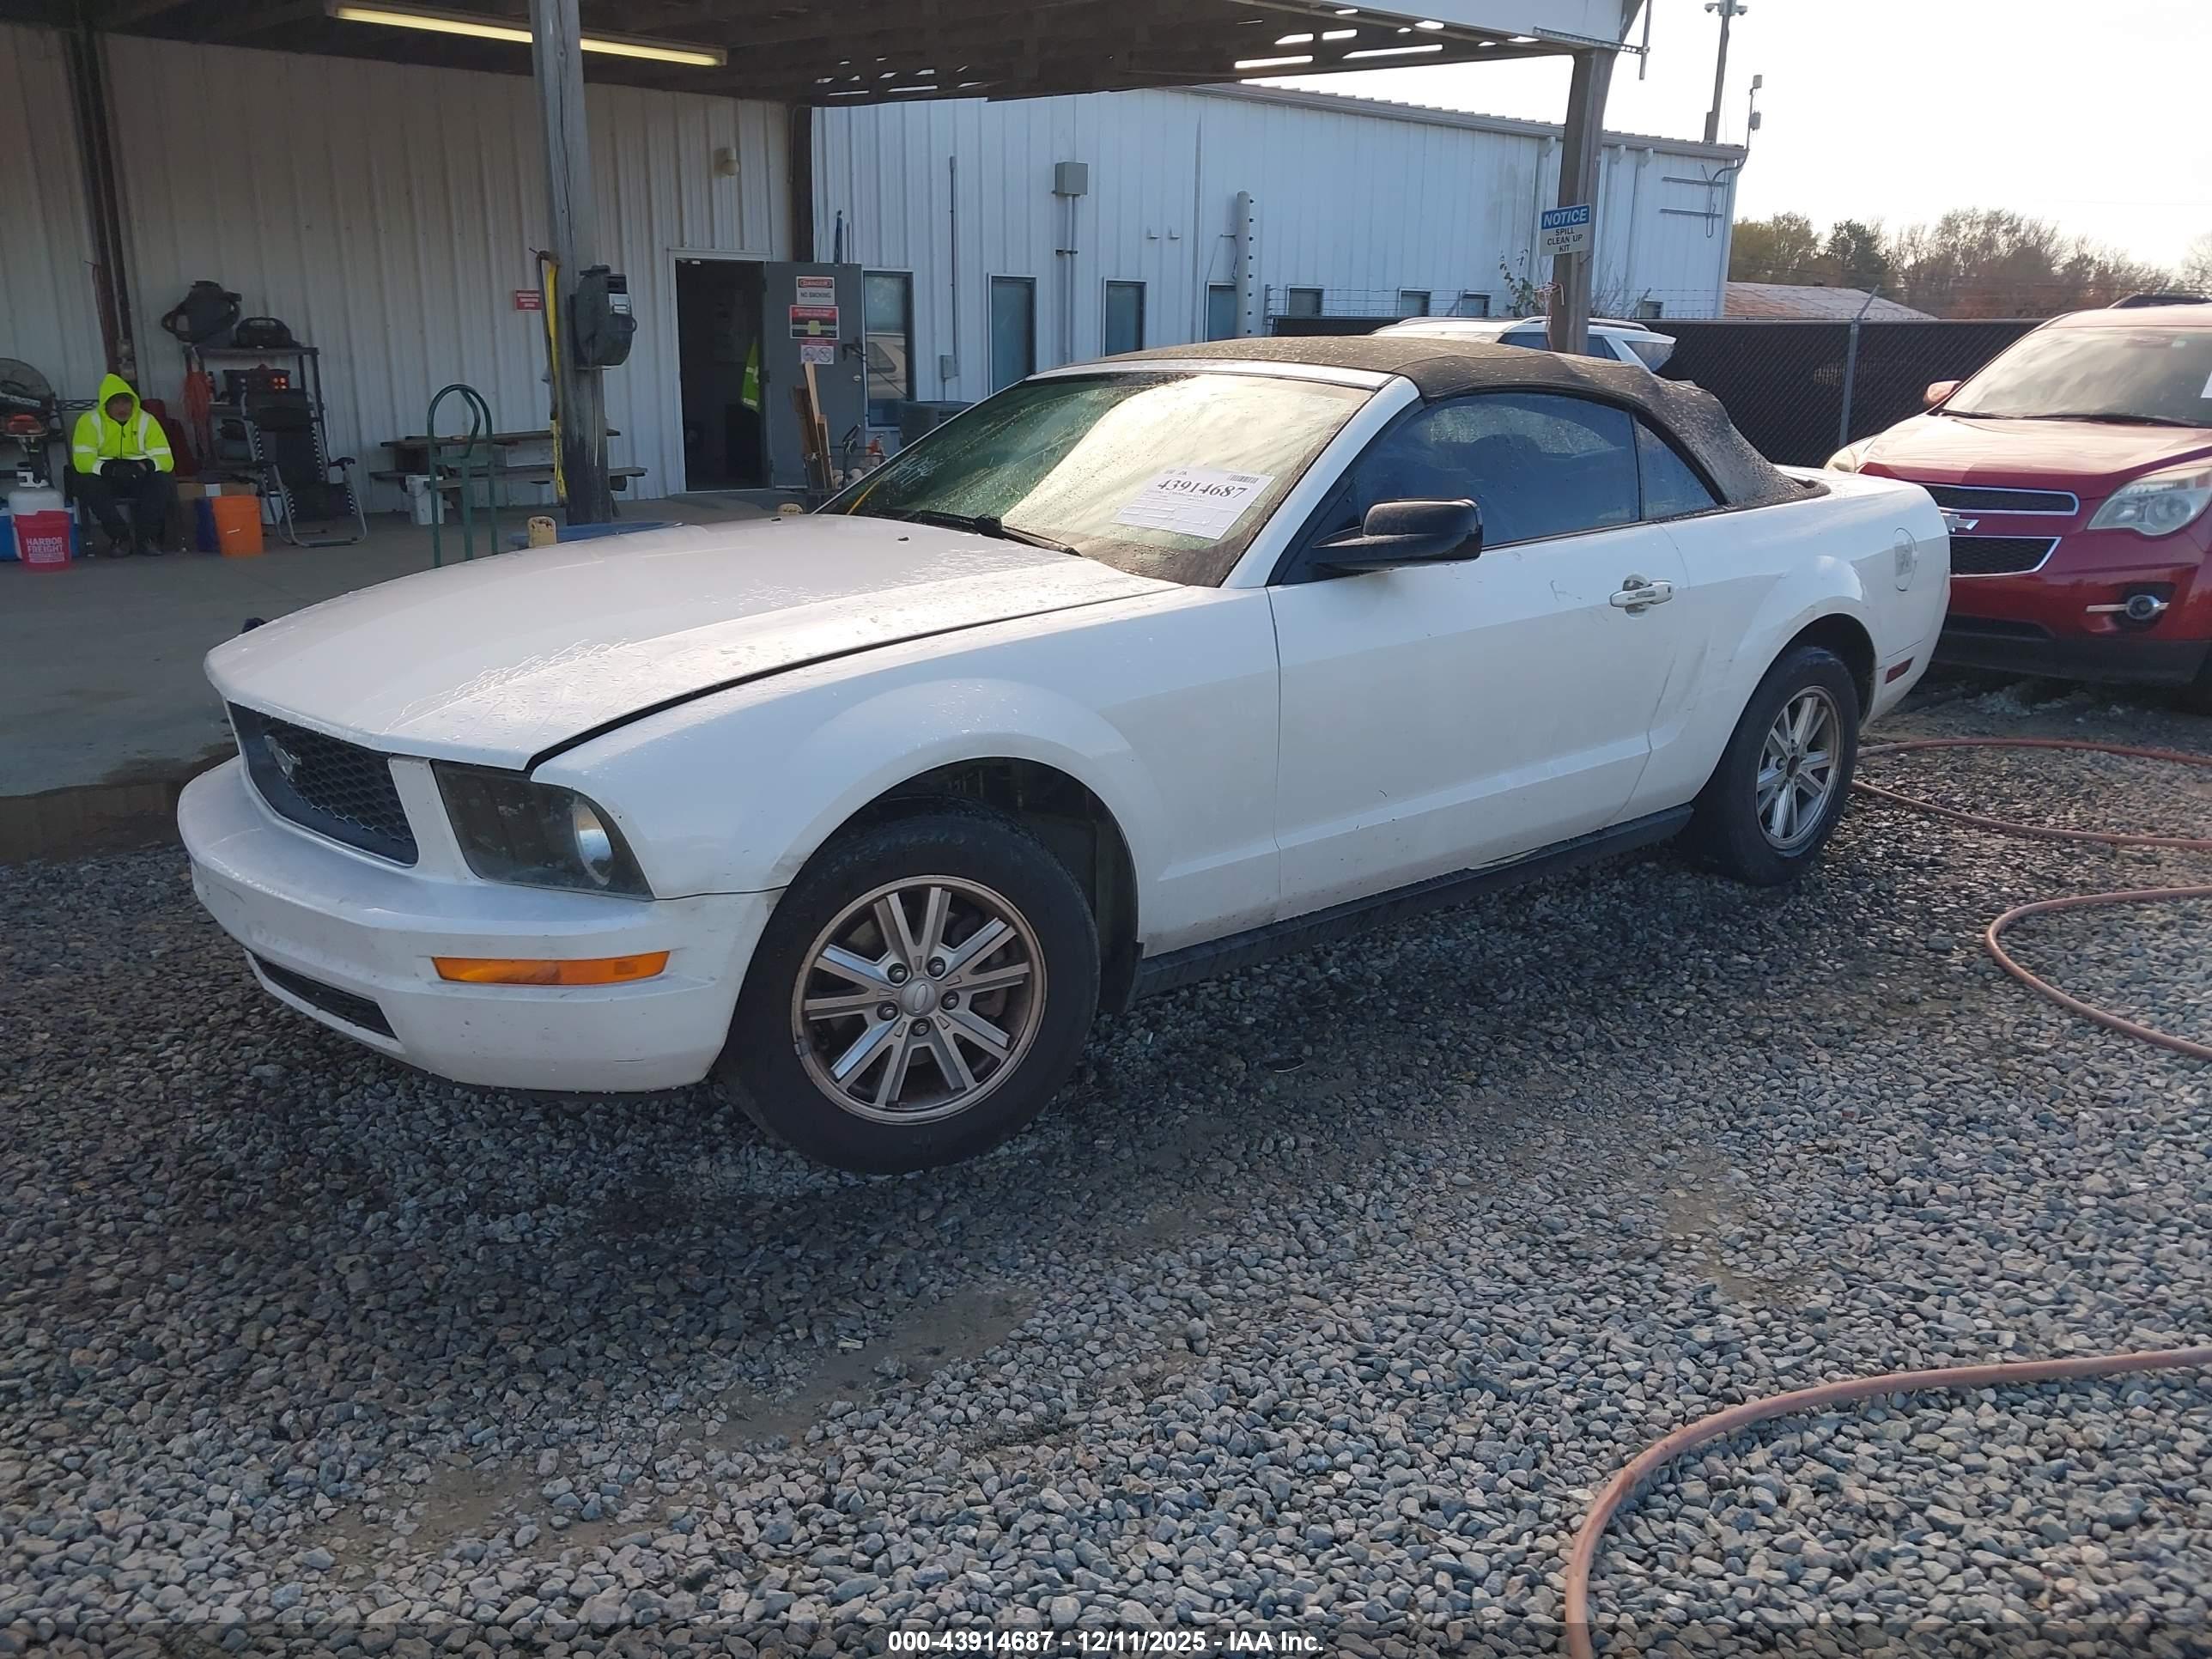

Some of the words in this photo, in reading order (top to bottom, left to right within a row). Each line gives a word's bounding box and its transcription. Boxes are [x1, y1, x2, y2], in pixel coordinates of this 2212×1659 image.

[1543, 208, 1588, 228] NOTICE
[1555, 227, 1575, 236] SPILL
[1547, 236, 1571, 246] CLEAN
[1572, 234, 1583, 243] UP
[1559, 244, 1571, 252] KIT
[1158, 478, 1249, 499] 43914687
[26, 537, 63, 546] HARBOR
[27, 544, 63, 554] FREIGHT
